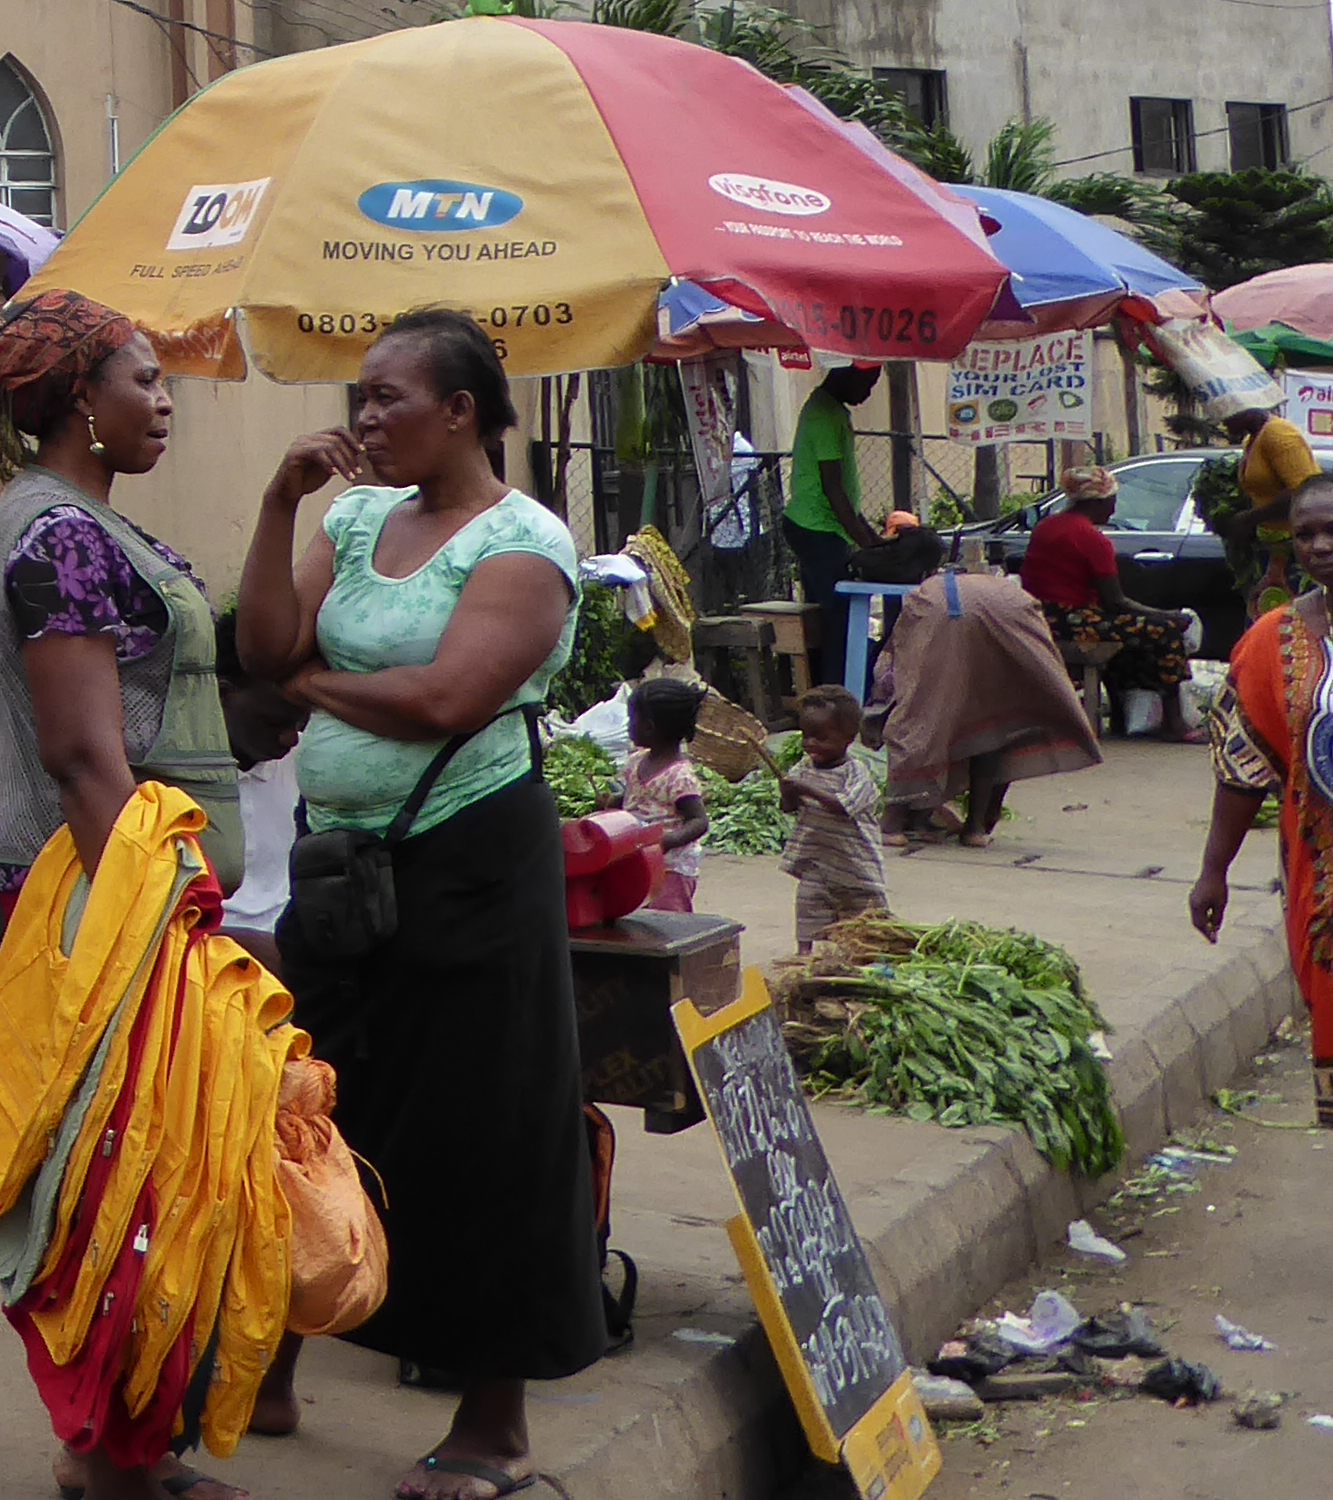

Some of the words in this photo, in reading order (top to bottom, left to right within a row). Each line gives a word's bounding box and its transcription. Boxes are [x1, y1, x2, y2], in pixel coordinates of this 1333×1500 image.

[715, 177, 824, 208] visafone
[182, 186, 262, 235] ZOOM
[387, 189, 494, 221] MTN
[323, 241, 414, 260] MOVING
[421, 244, 471, 261] YOU
[476, 240, 557, 261] AHEAD
[864, 234, 904, 247] WORLD
[130, 264, 164, 278] FULL
[171, 263, 211, 279] SPEED
[950, 371, 1018, 383] YOUR
[1026, 362, 1085, 381] LOST
[951, 383, 998, 399] SIM
[1010, 374, 1085, 396] CARD
